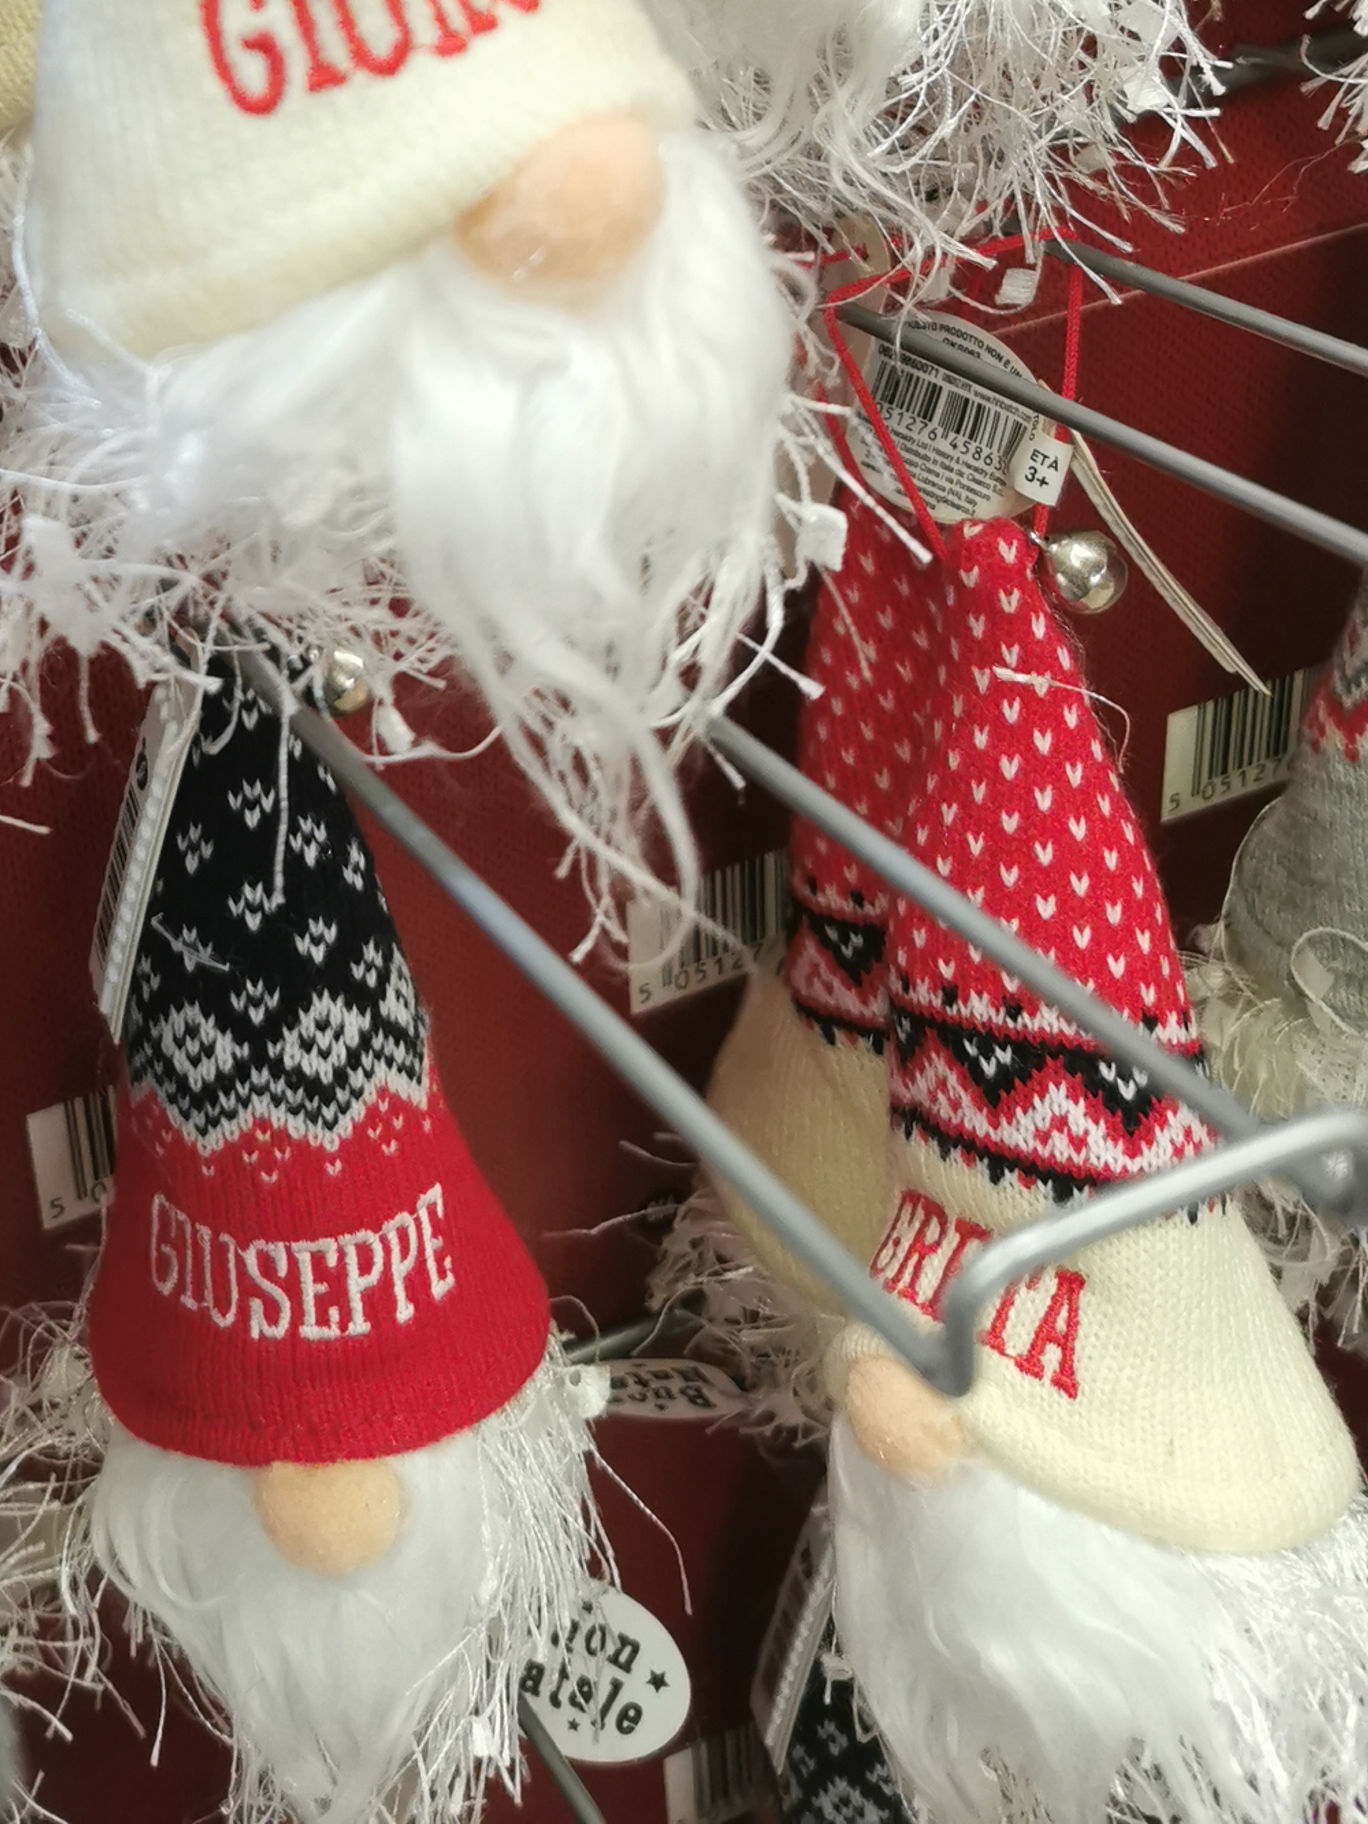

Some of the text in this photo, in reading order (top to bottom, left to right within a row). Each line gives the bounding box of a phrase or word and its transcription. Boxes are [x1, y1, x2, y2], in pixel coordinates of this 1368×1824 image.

[1030, 448, 1059, 472] ETÀ
[1024, 465, 1049, 488] 3+
[149, 1181, 456, 1342] GIUSEPPE
